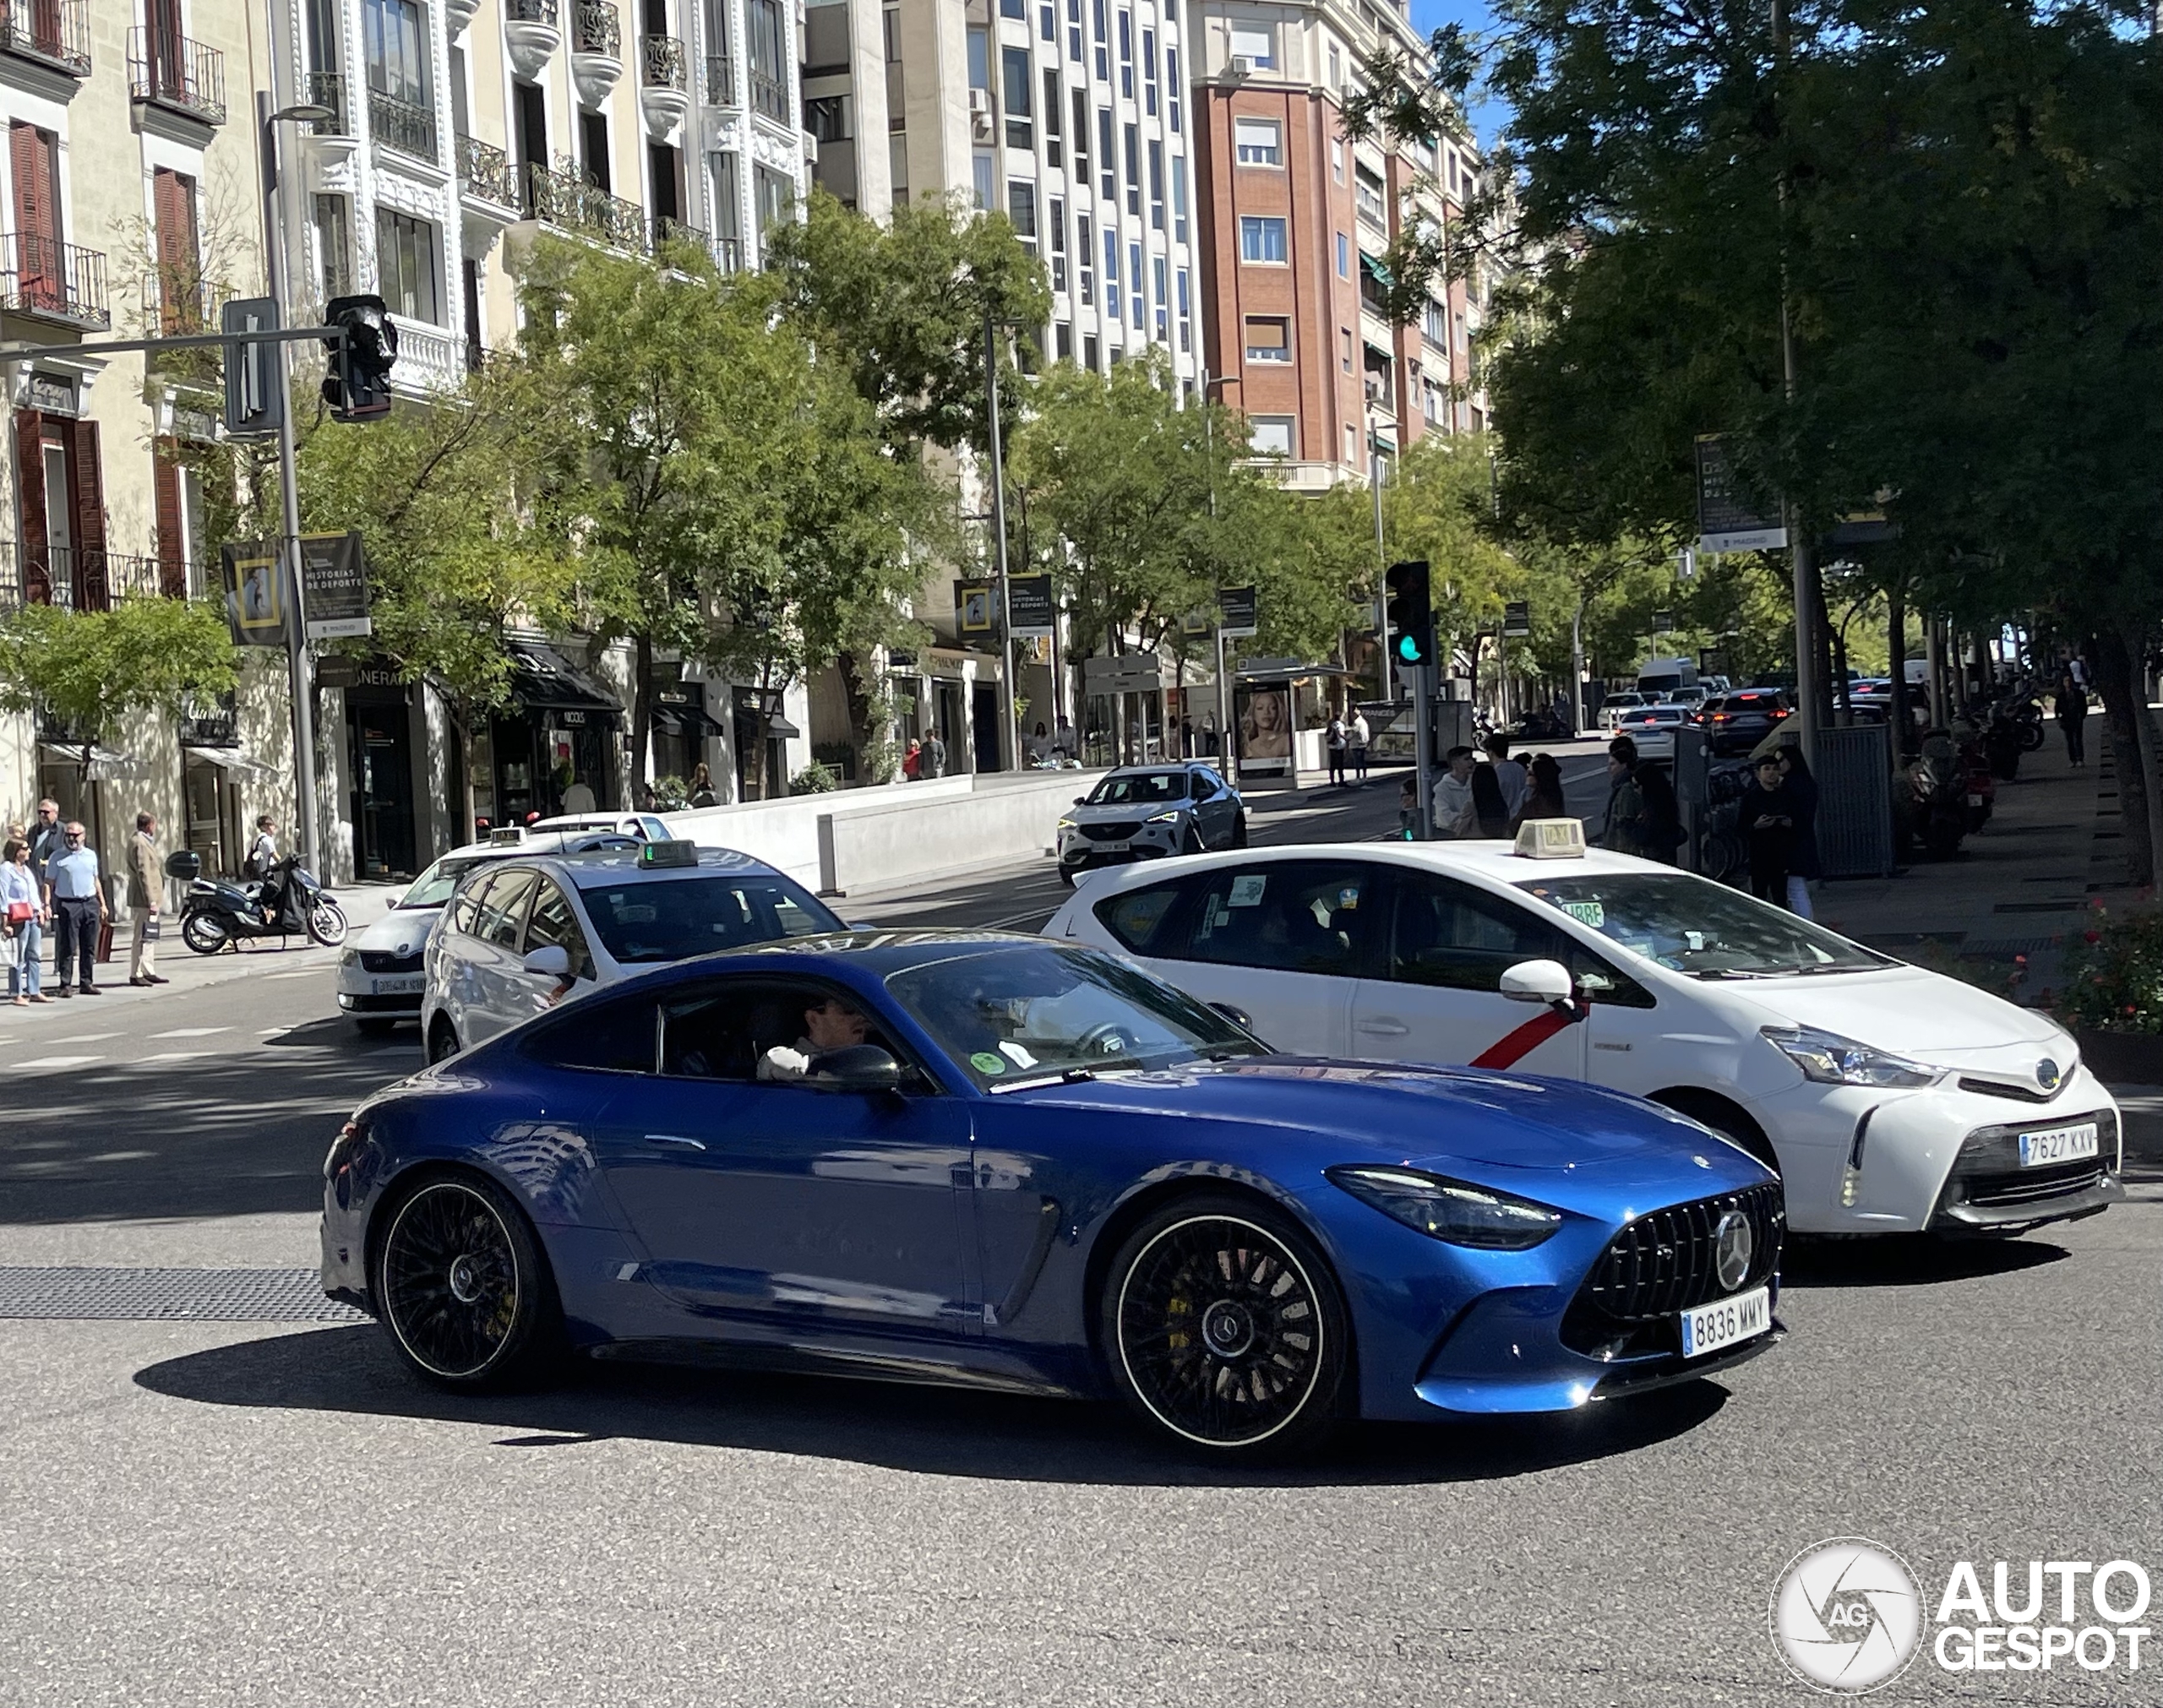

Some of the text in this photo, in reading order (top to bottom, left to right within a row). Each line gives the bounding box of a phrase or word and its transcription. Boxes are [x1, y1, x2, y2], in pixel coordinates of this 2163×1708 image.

[306, 568, 355, 580] HISTORIAS
[307, 578, 362, 590] DE DEPORTE
[2030, 1128, 2094, 1161] 7627 KXV
[1696, 1295, 1764, 1347] 8836 MMY
